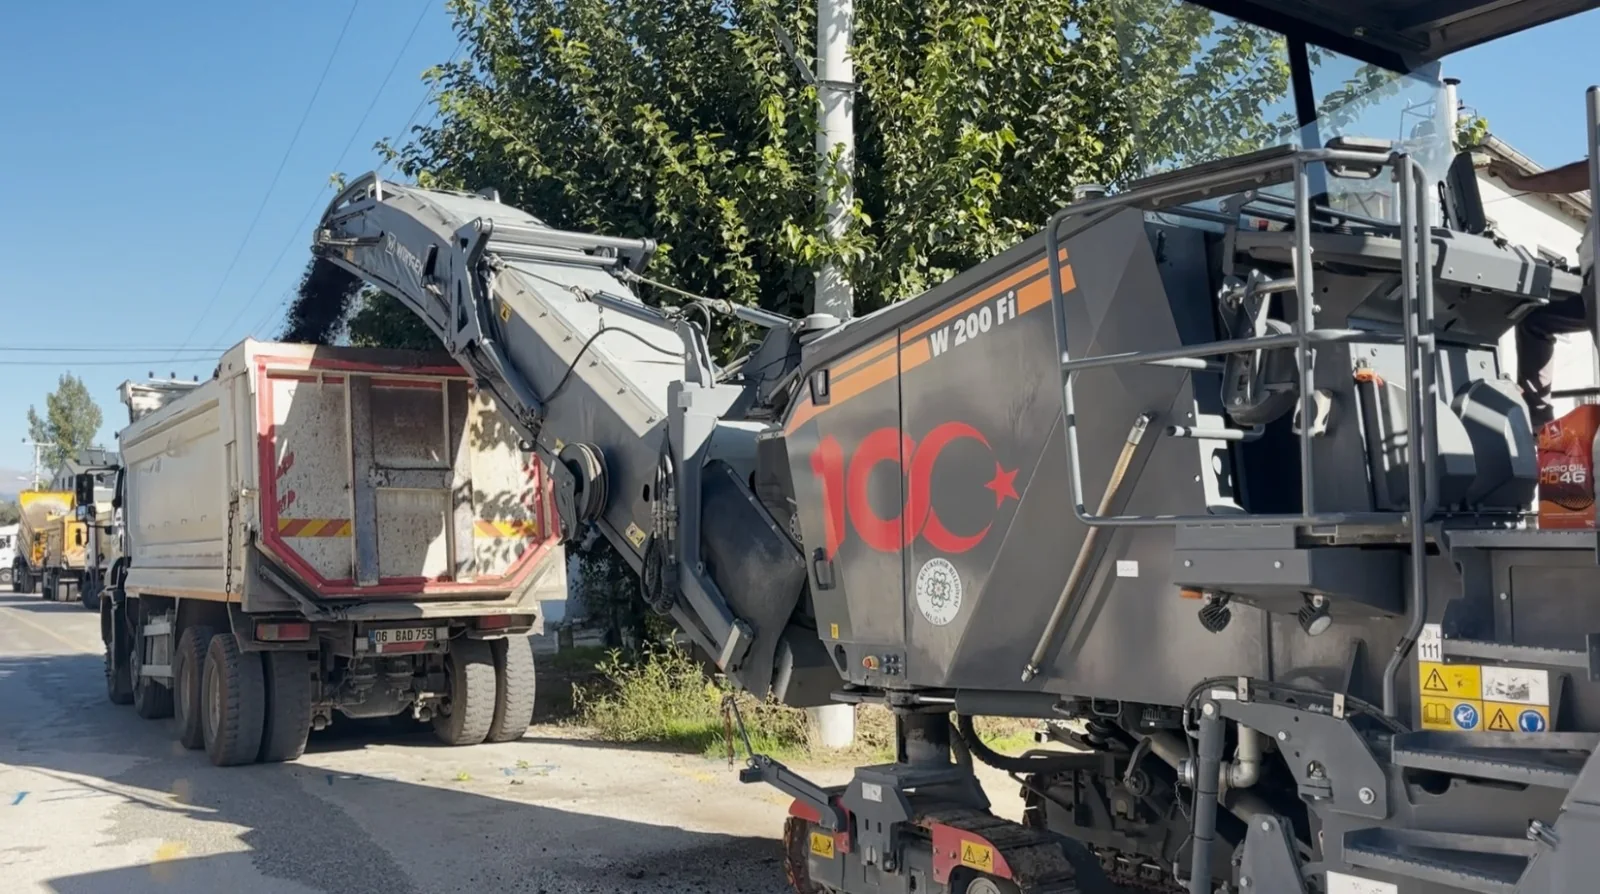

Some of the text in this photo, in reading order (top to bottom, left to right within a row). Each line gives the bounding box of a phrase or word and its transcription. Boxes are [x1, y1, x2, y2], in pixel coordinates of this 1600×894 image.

[930, 290, 1016, 357] W 200 Fi
[1568, 463, 1587, 472] OIL
[375, 628, 433, 642] 06 BAD 755
[1421, 643, 1439, 659] 111
